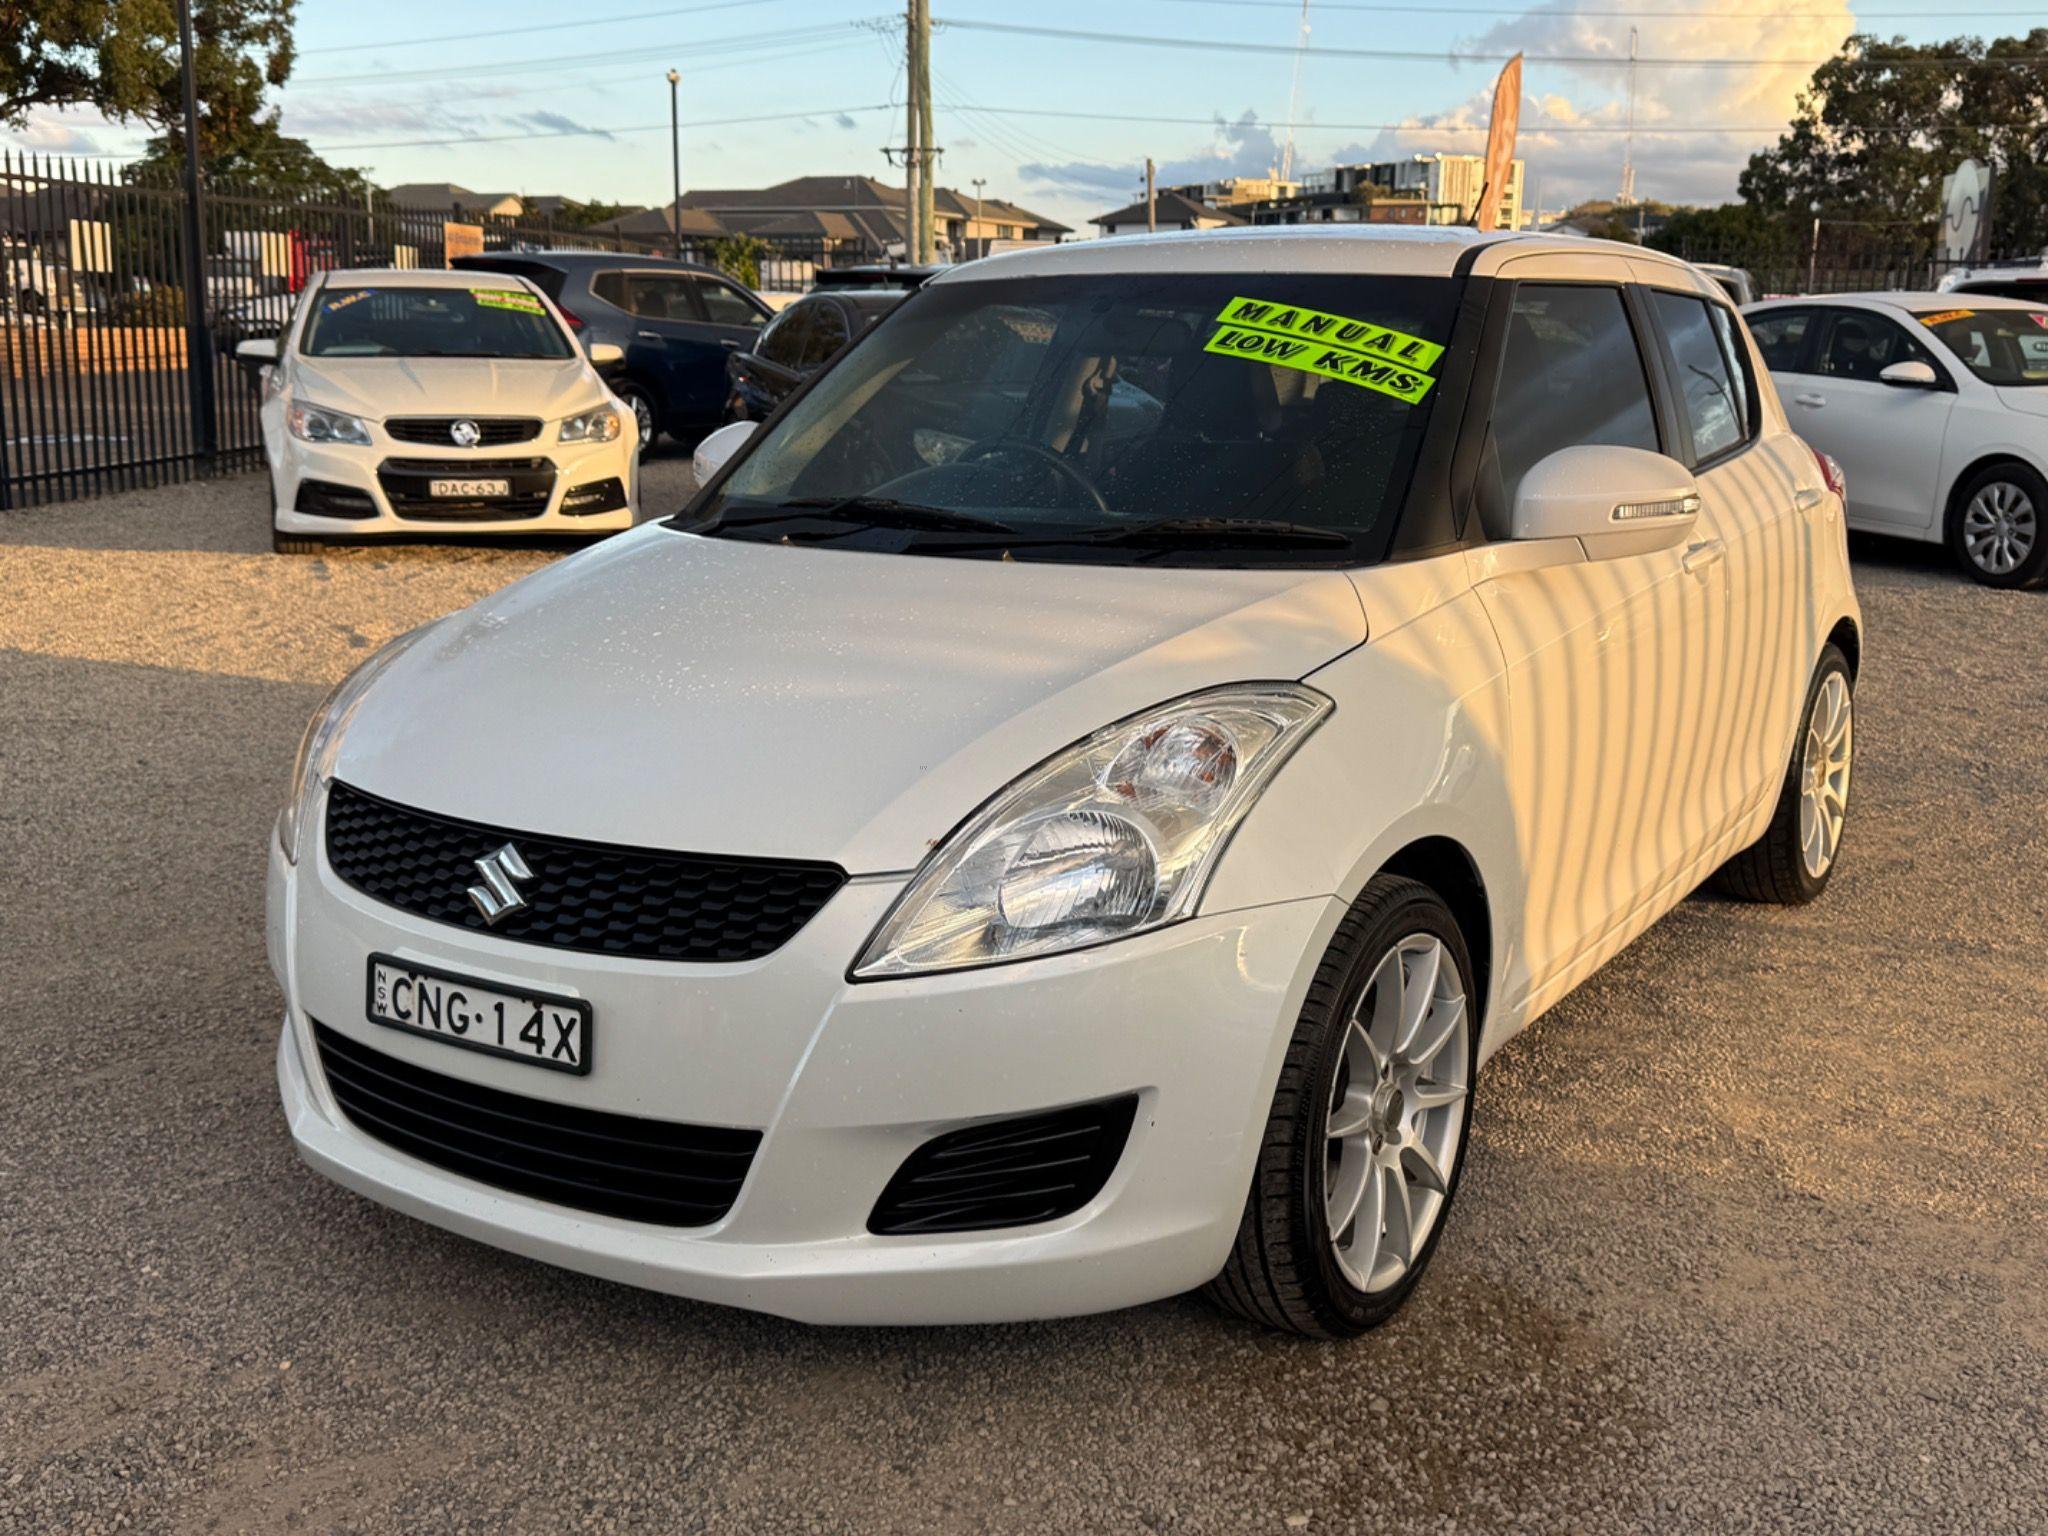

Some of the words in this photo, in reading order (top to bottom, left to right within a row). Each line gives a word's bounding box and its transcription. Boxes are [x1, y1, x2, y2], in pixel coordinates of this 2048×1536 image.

[1216, 331, 1308, 359] LOW
[1315, 351, 1423, 393] KMS
[1232, 302, 1423, 362] MANUAL
